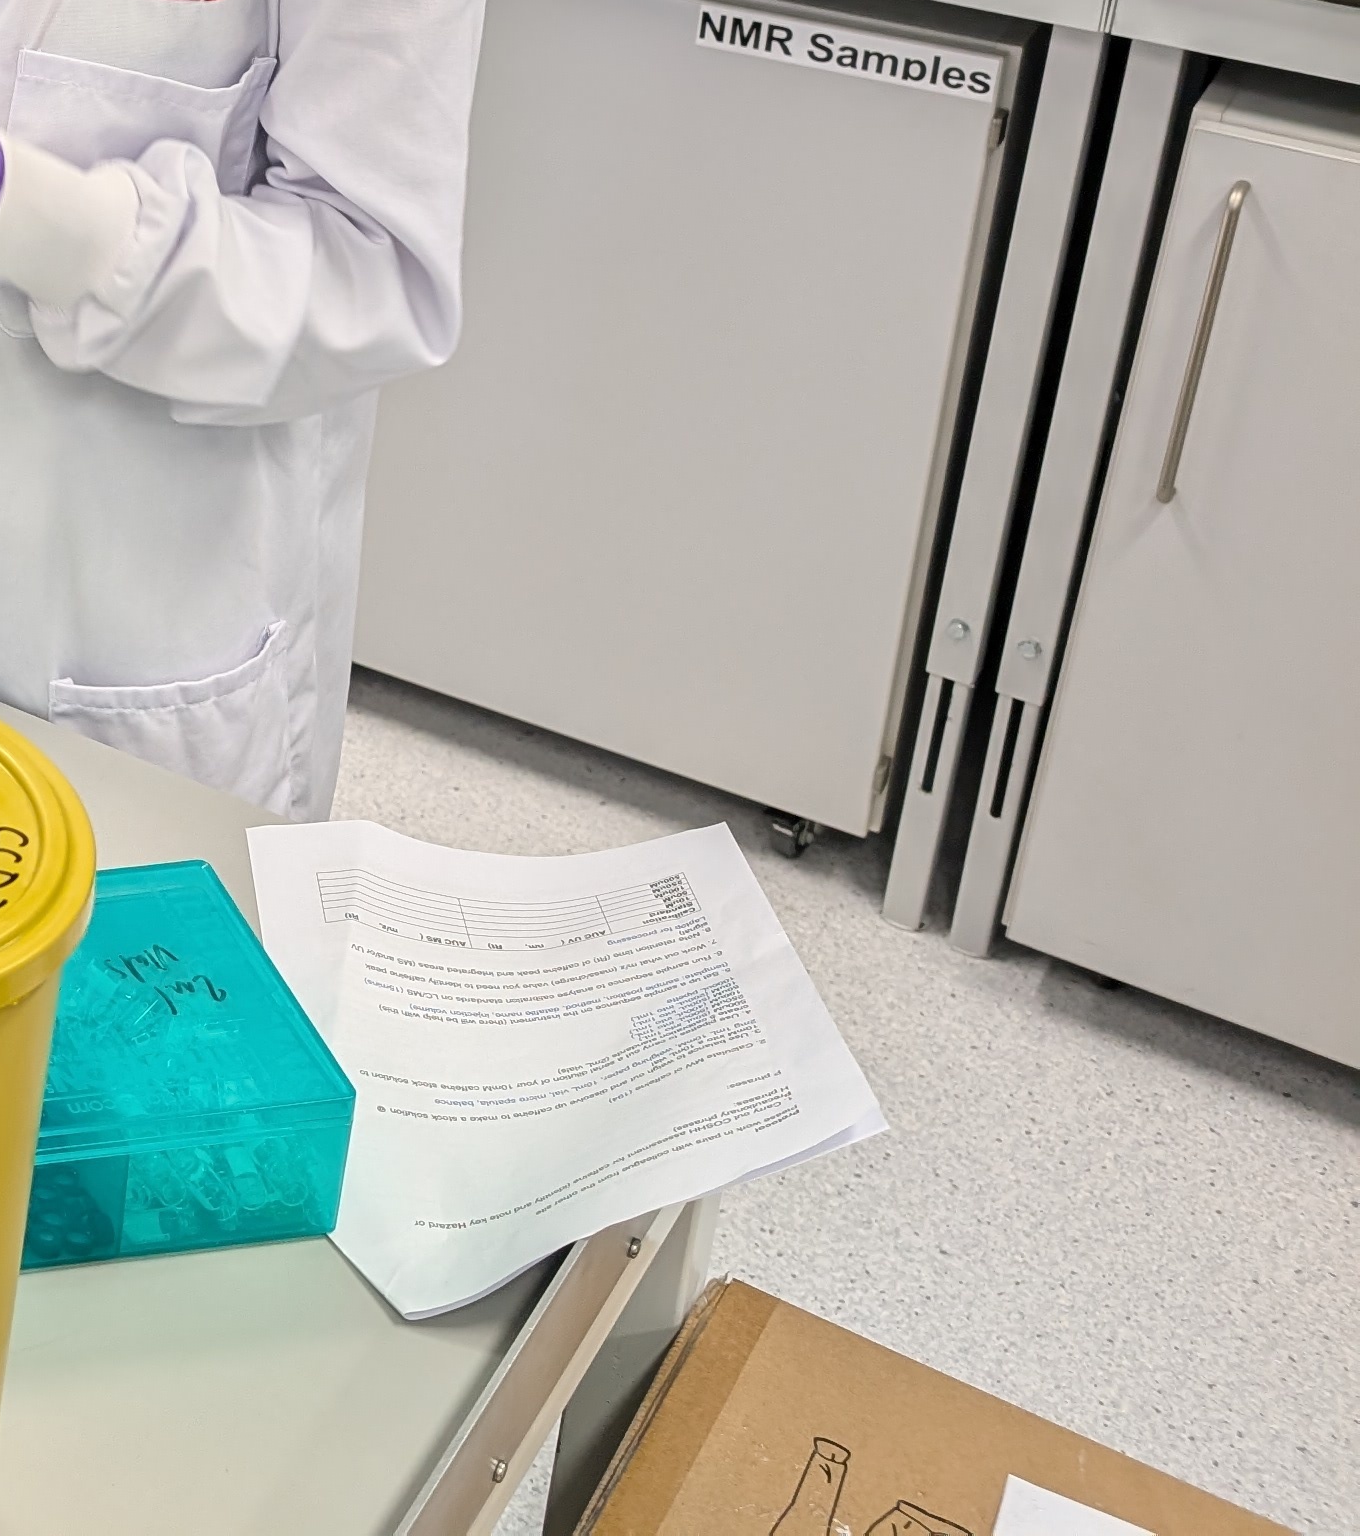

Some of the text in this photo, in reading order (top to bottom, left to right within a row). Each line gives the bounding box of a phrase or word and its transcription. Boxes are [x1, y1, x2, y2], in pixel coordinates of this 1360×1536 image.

[698, 11, 992, 95] NMR Samples
[642, 907, 696, 925] Calibration
[648, 901, 694, 918] Standard
[389, 1107, 428, 1119] solution
[512, 1106, 552, 1118] caffeine
[752, 1101, 782, 1115] Carry
[763, 1104, 798, 1123] Please
[431, 1113, 457, 1122] stock
[469, 1115, 498, 1123] make
[732, 1111, 750, 1122] out
[754, 1108, 799, 1132] Protocol
[688, 1117, 731, 1134] COSHH
[736, 1118, 761, 1131] work
[626, 1129, 686, 1157] assessment
[695, 1130, 721, 1145] pairs
[671, 1140, 693, 1152] with
[611, 1156, 625, 1165] for
[621, 1149, 669, 1173] colleague
[572, 1162, 609, 1183] caffeine
[597, 1170, 620, 1182] from
[580, 1182, 595, 1191] the
[553, 1190, 578, 1204] other
[513, 1201, 531, 1214] and
[535, 1204, 552, 1215] site
[489, 1210, 511, 1220] note
[428, 1221, 466, 1230] Hazard
[469, 1217, 487, 1227] key
